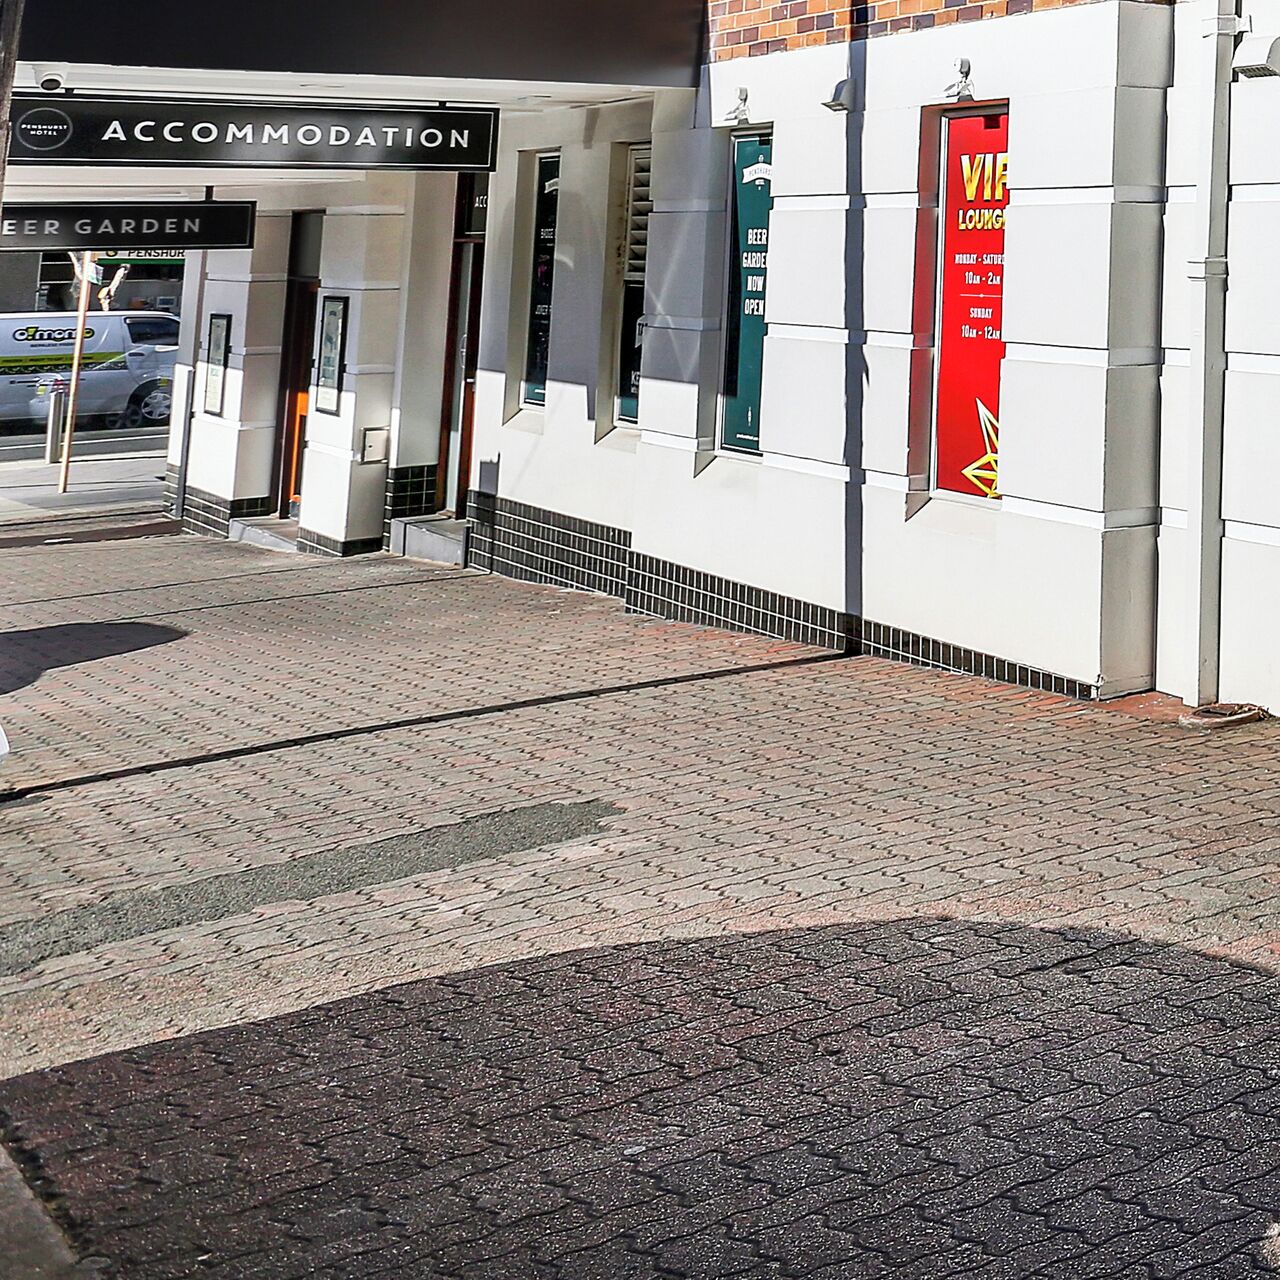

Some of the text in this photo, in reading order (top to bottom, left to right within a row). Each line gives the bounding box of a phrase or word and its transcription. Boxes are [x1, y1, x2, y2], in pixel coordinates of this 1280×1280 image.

[101, 120, 470, 148] ACCOMMODATION
[74, 219, 200, 234] GARDEN
[958, 208, 1007, 230] LOUNG
[747, 228, 767, 245] BEER
[742, 252, 767, 268] GARDE
[955, 253, 977, 264] MONDAY
[746, 276, 764, 291] NOW
[744, 299, 764, 315] OPEN
[970, 307, 993, 318] SUNDAY
